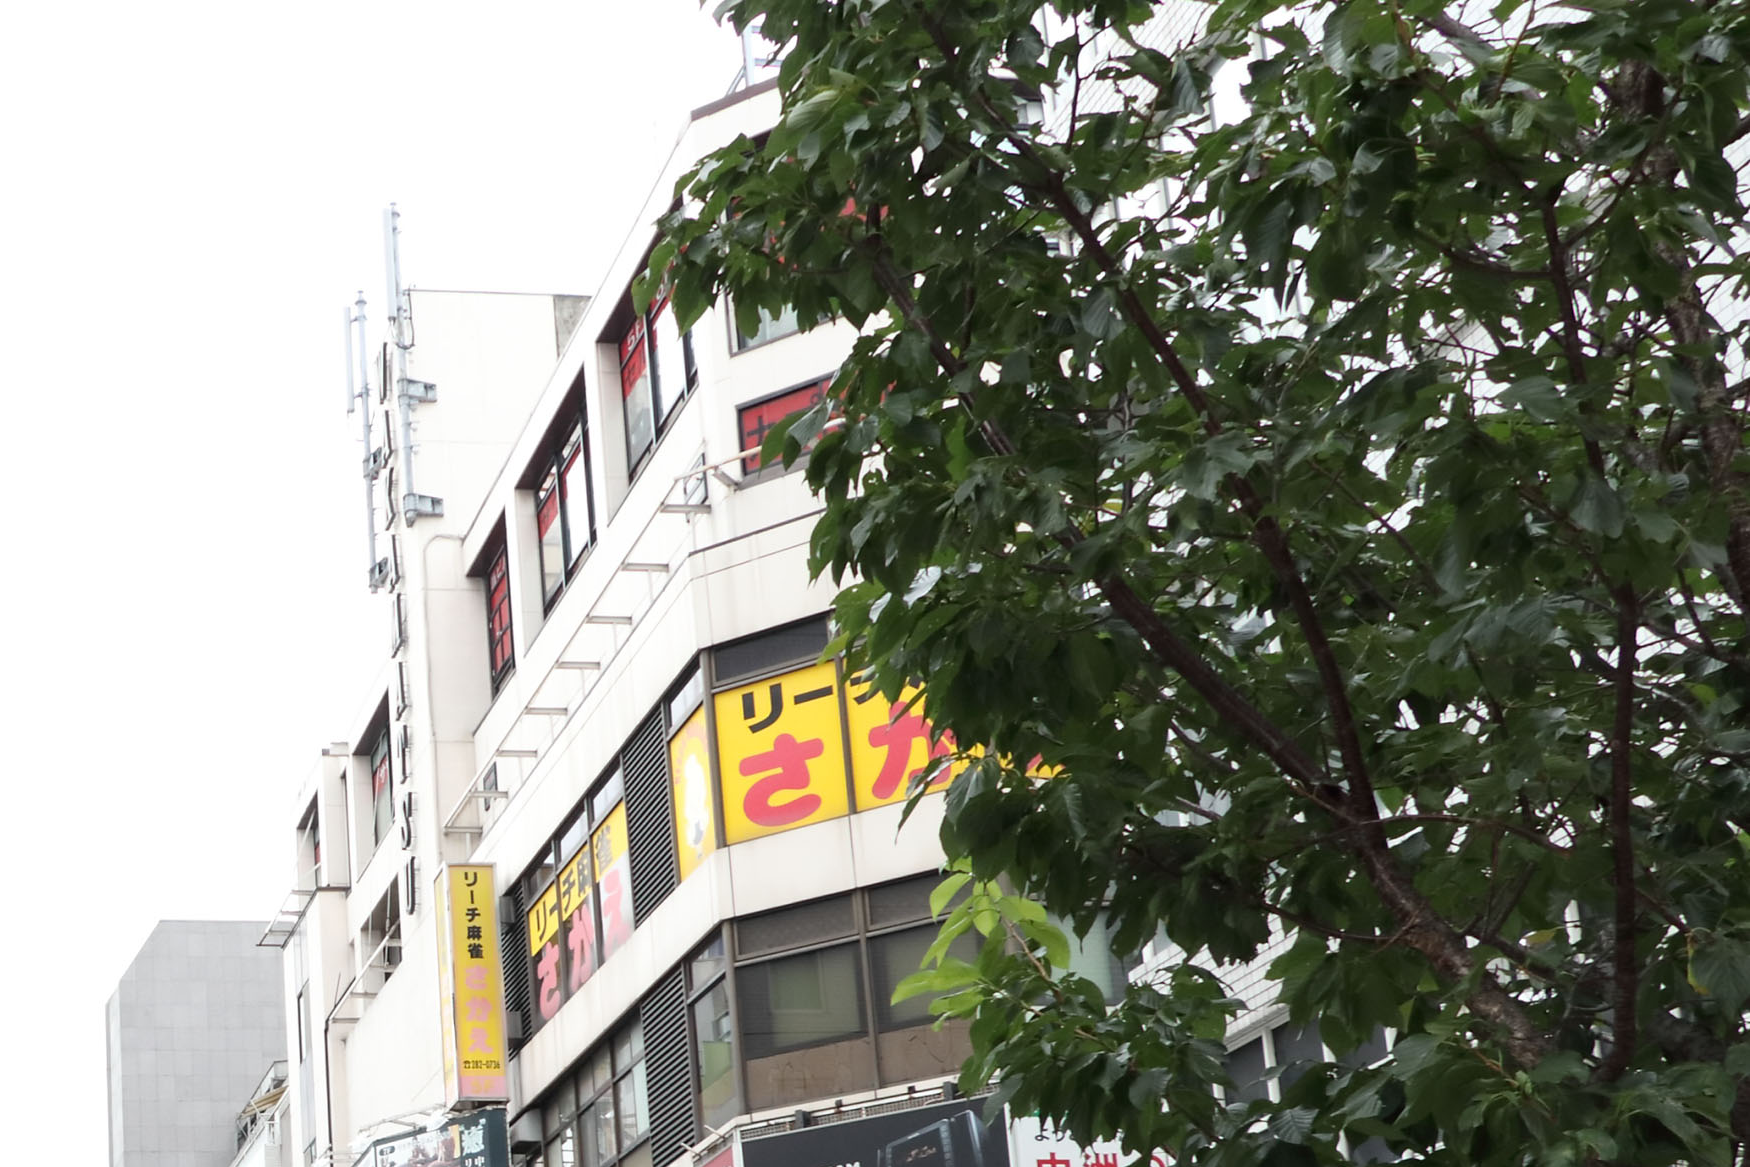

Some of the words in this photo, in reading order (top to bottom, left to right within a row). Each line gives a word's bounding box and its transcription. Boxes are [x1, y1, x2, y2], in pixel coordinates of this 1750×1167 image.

[463, 871, 484, 960] リーチ麻雀
[464, 966, 495, 1054] さかえ
